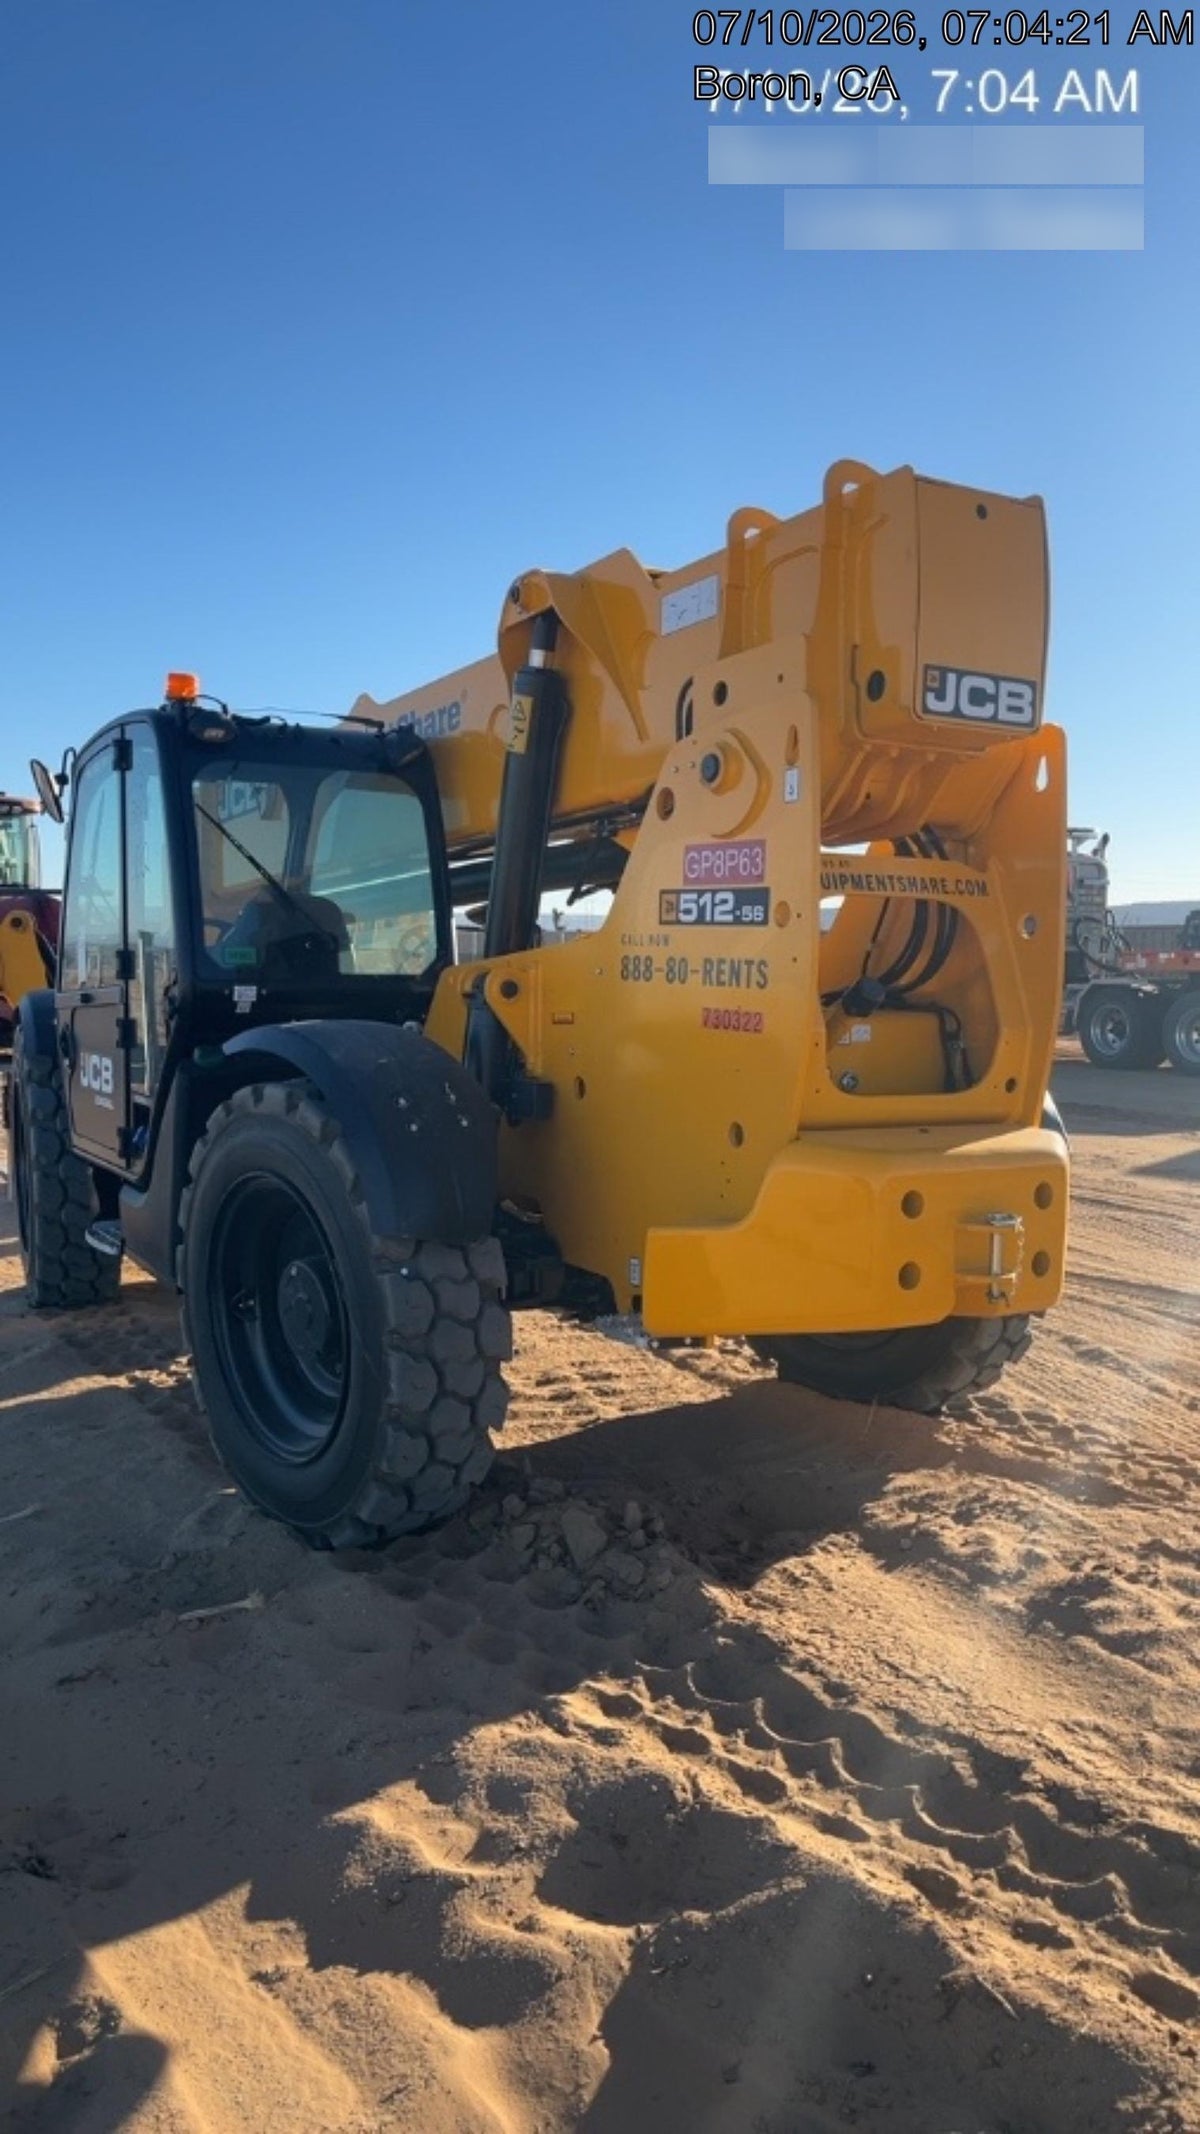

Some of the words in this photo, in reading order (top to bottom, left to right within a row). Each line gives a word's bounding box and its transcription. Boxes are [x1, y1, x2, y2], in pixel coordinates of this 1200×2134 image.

[925, 672, 1033, 724] JCB
[685, 847, 763, 879] GP8P63
[620, 955, 769, 990] 888-80-RENTS
[702, 1006, 763, 1033] 730322
[81, 1052, 113, 1094] JCB
